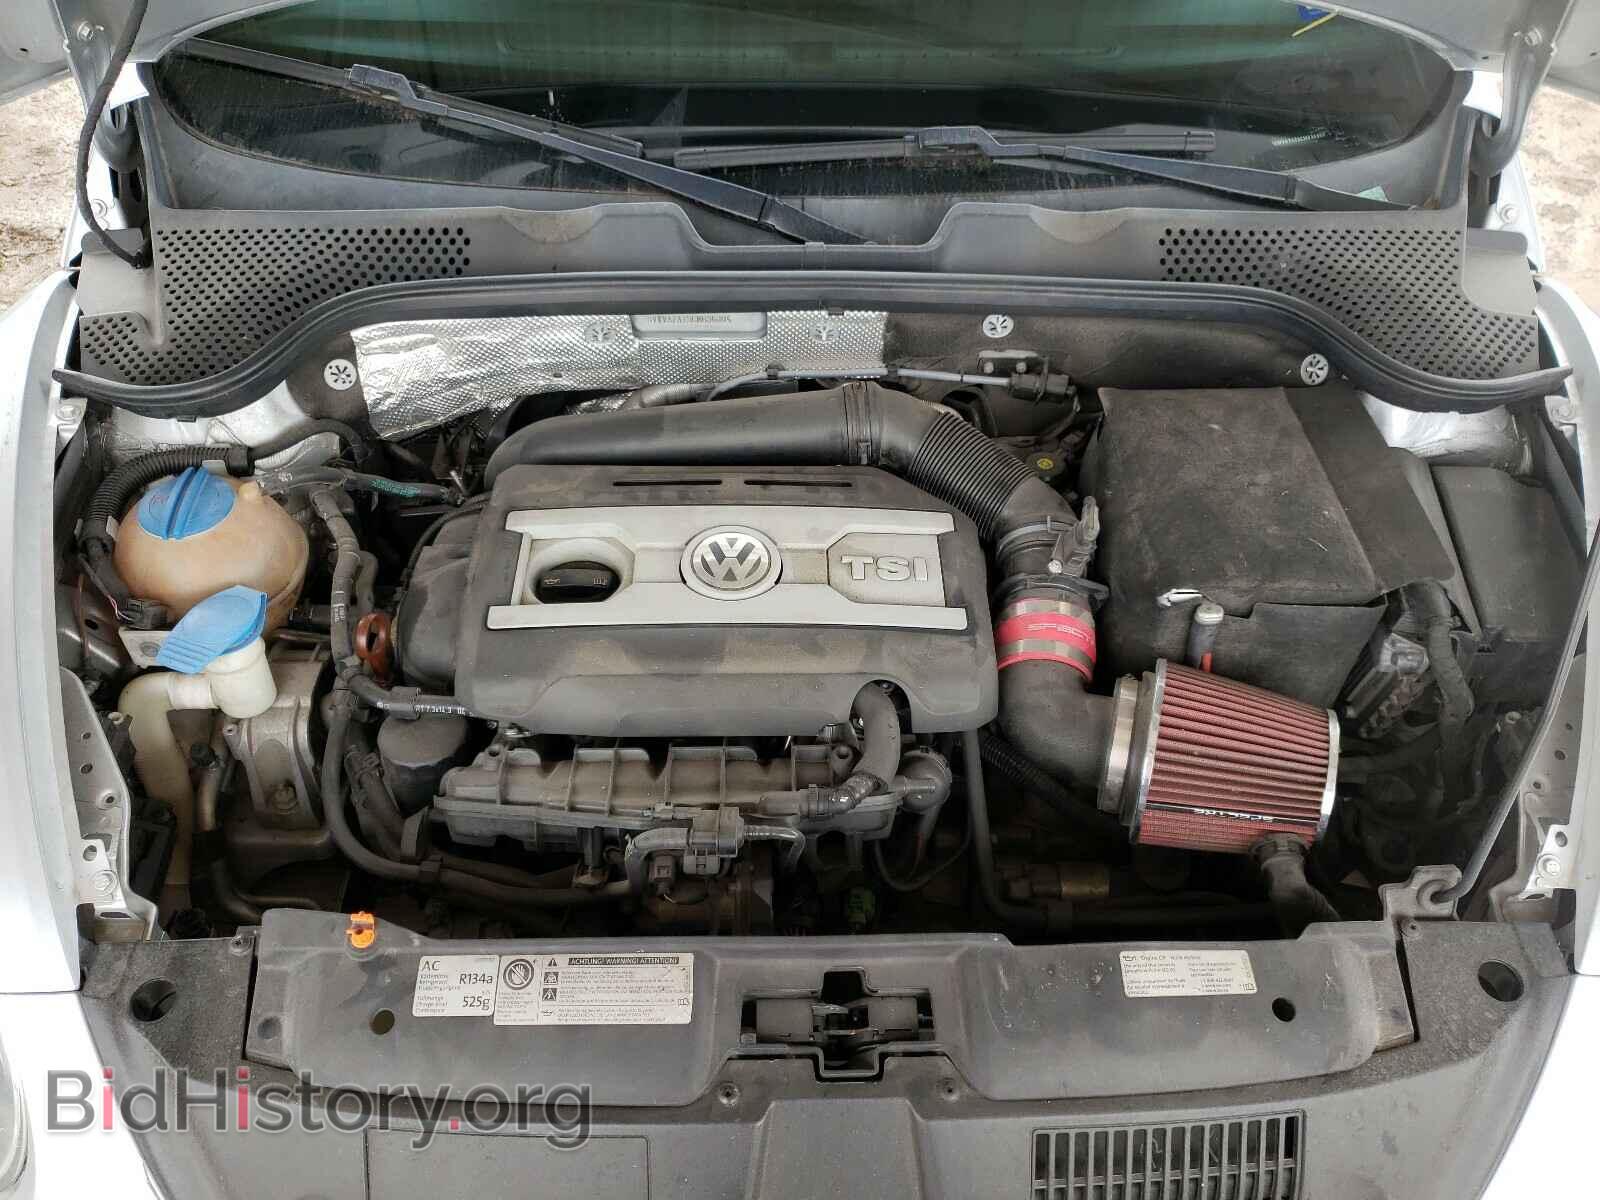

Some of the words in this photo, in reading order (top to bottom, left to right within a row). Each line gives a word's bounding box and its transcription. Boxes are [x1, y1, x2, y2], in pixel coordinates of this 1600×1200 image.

[841, 555, 928, 581] TSI
[421, 960, 441, 972] AC
[606, 957, 638, 965] WARNING!
[639, 957, 678, 965] ATTENTION!
[459, 972, 493, 985] R134a
[463, 995, 491, 1011] 525g
